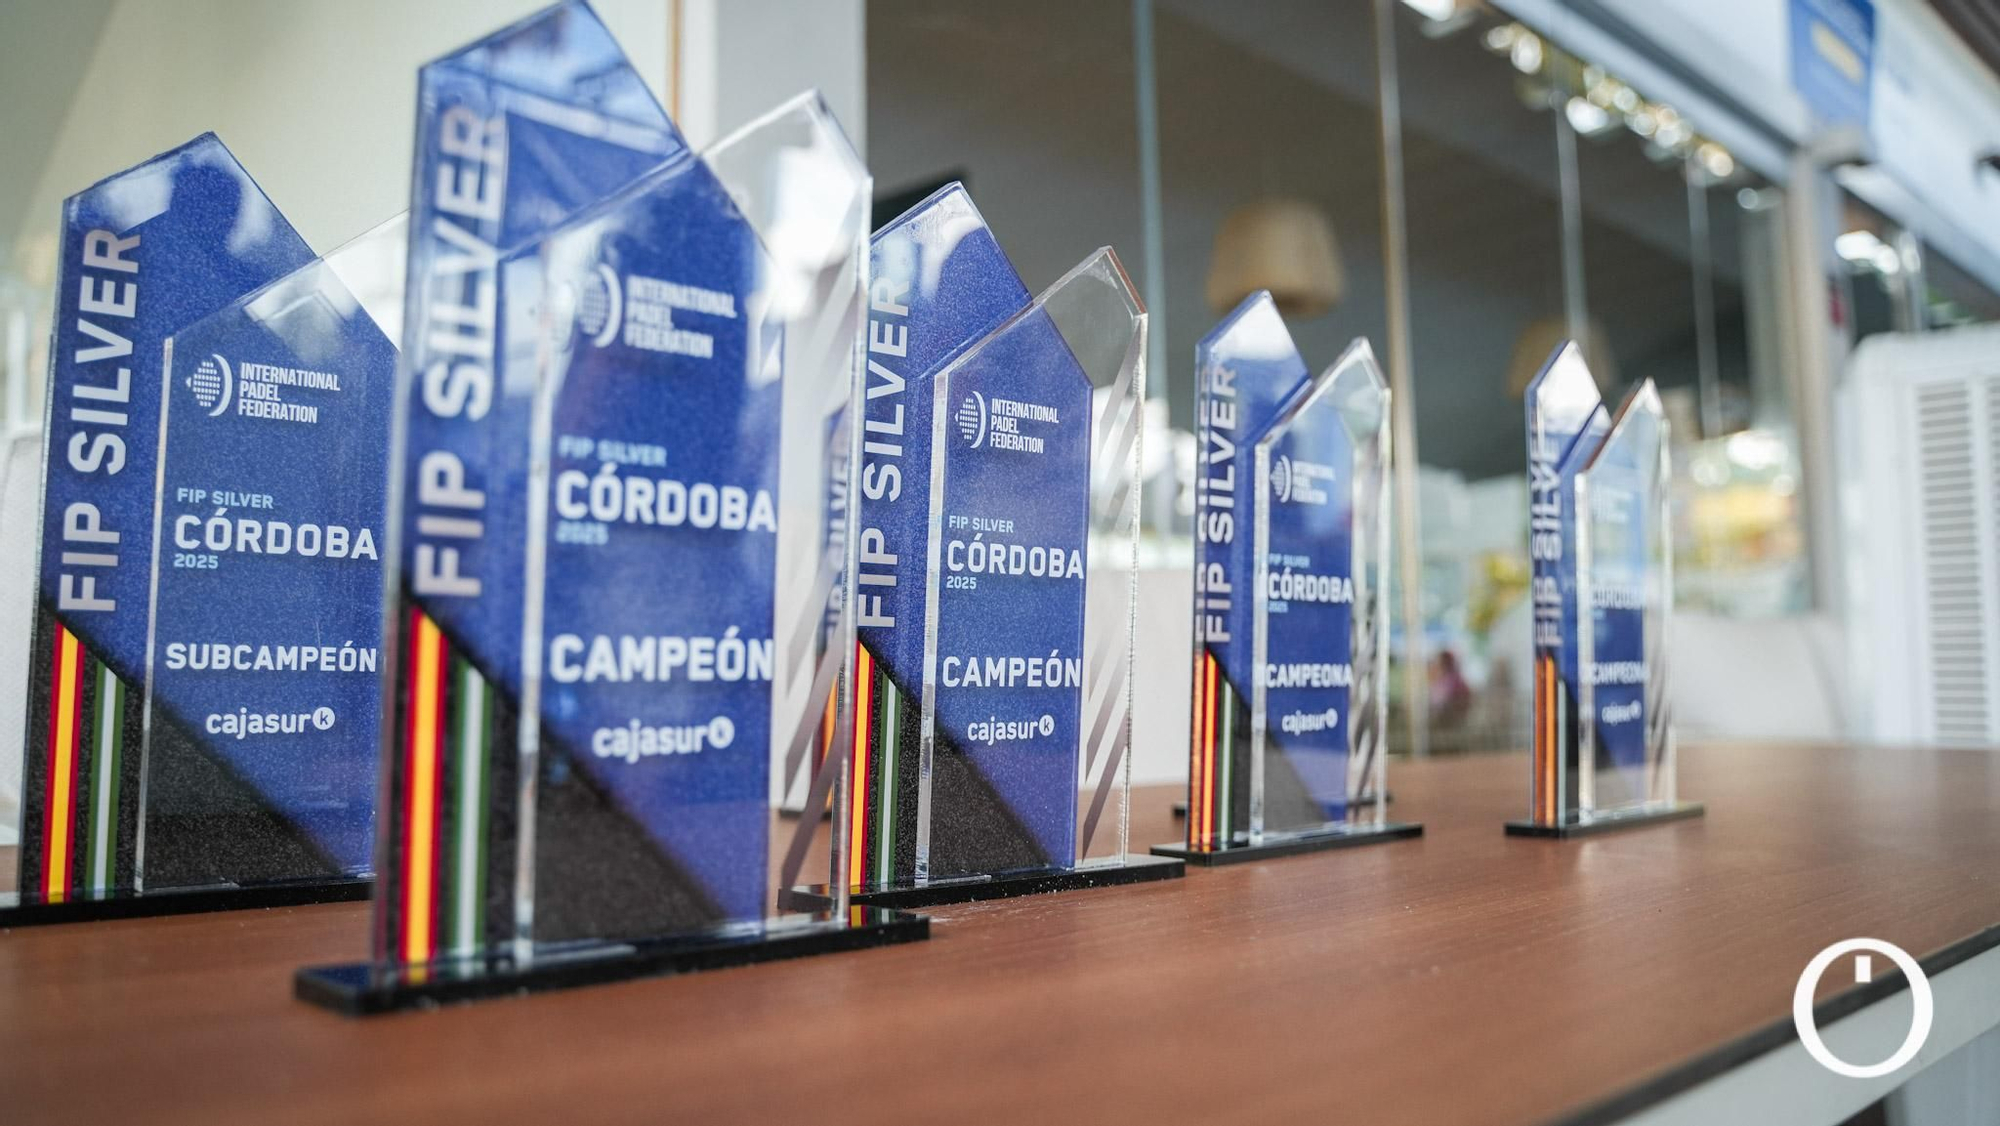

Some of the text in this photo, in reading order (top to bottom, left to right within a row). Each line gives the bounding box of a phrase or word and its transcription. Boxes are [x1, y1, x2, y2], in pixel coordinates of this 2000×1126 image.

[626, 275, 738, 319] INTERNATIONAL
[626, 304, 675, 330] PADEL
[414, 104, 506, 597] FIP SILVER
[623, 328, 714, 359] FEDERATION
[240, 362, 341, 391] INTERNATIONAL
[240, 380, 282, 402] PADEL
[58, 229, 141, 611] FIP SILVER
[238, 399, 318, 424] FEDERATION
[991, 398, 1059, 424] INTERNATIONAL
[991, 415, 1019, 434] PADEL
[558, 435, 667, 467] FIP SILVER
[857, 274, 910, 628] FIP SILVER
[990, 431, 1044, 454] FEDERATION
[177, 488, 274, 509] FIP SILVER
[555, 461, 778, 533] CÓRDOBA
[1206, 364, 1237, 642] FIP SILVER
[174, 507, 379, 561] CÓRDOBA
[555, 522, 609, 546] 2025
[949, 515, 1014, 533] FIP SILVER
[173, 553, 219, 569] 2025
[947, 532, 1085, 579] CÓRDOBA
[946, 576, 977, 590] 2025
[1268, 566, 1354, 603] CÓRDOBA
[165, 640, 377, 672] SUBCAMPEÓN
[549, 626, 774, 682] CAMPEÓN
[942, 650, 1082, 687] CAMPEÓN
[1265, 663, 1353, 688] CAMPEONA
[205, 707, 310, 740] cajasur
[967, 716, 1038, 745] cajasur
[592, 718, 708, 763] cajasur
